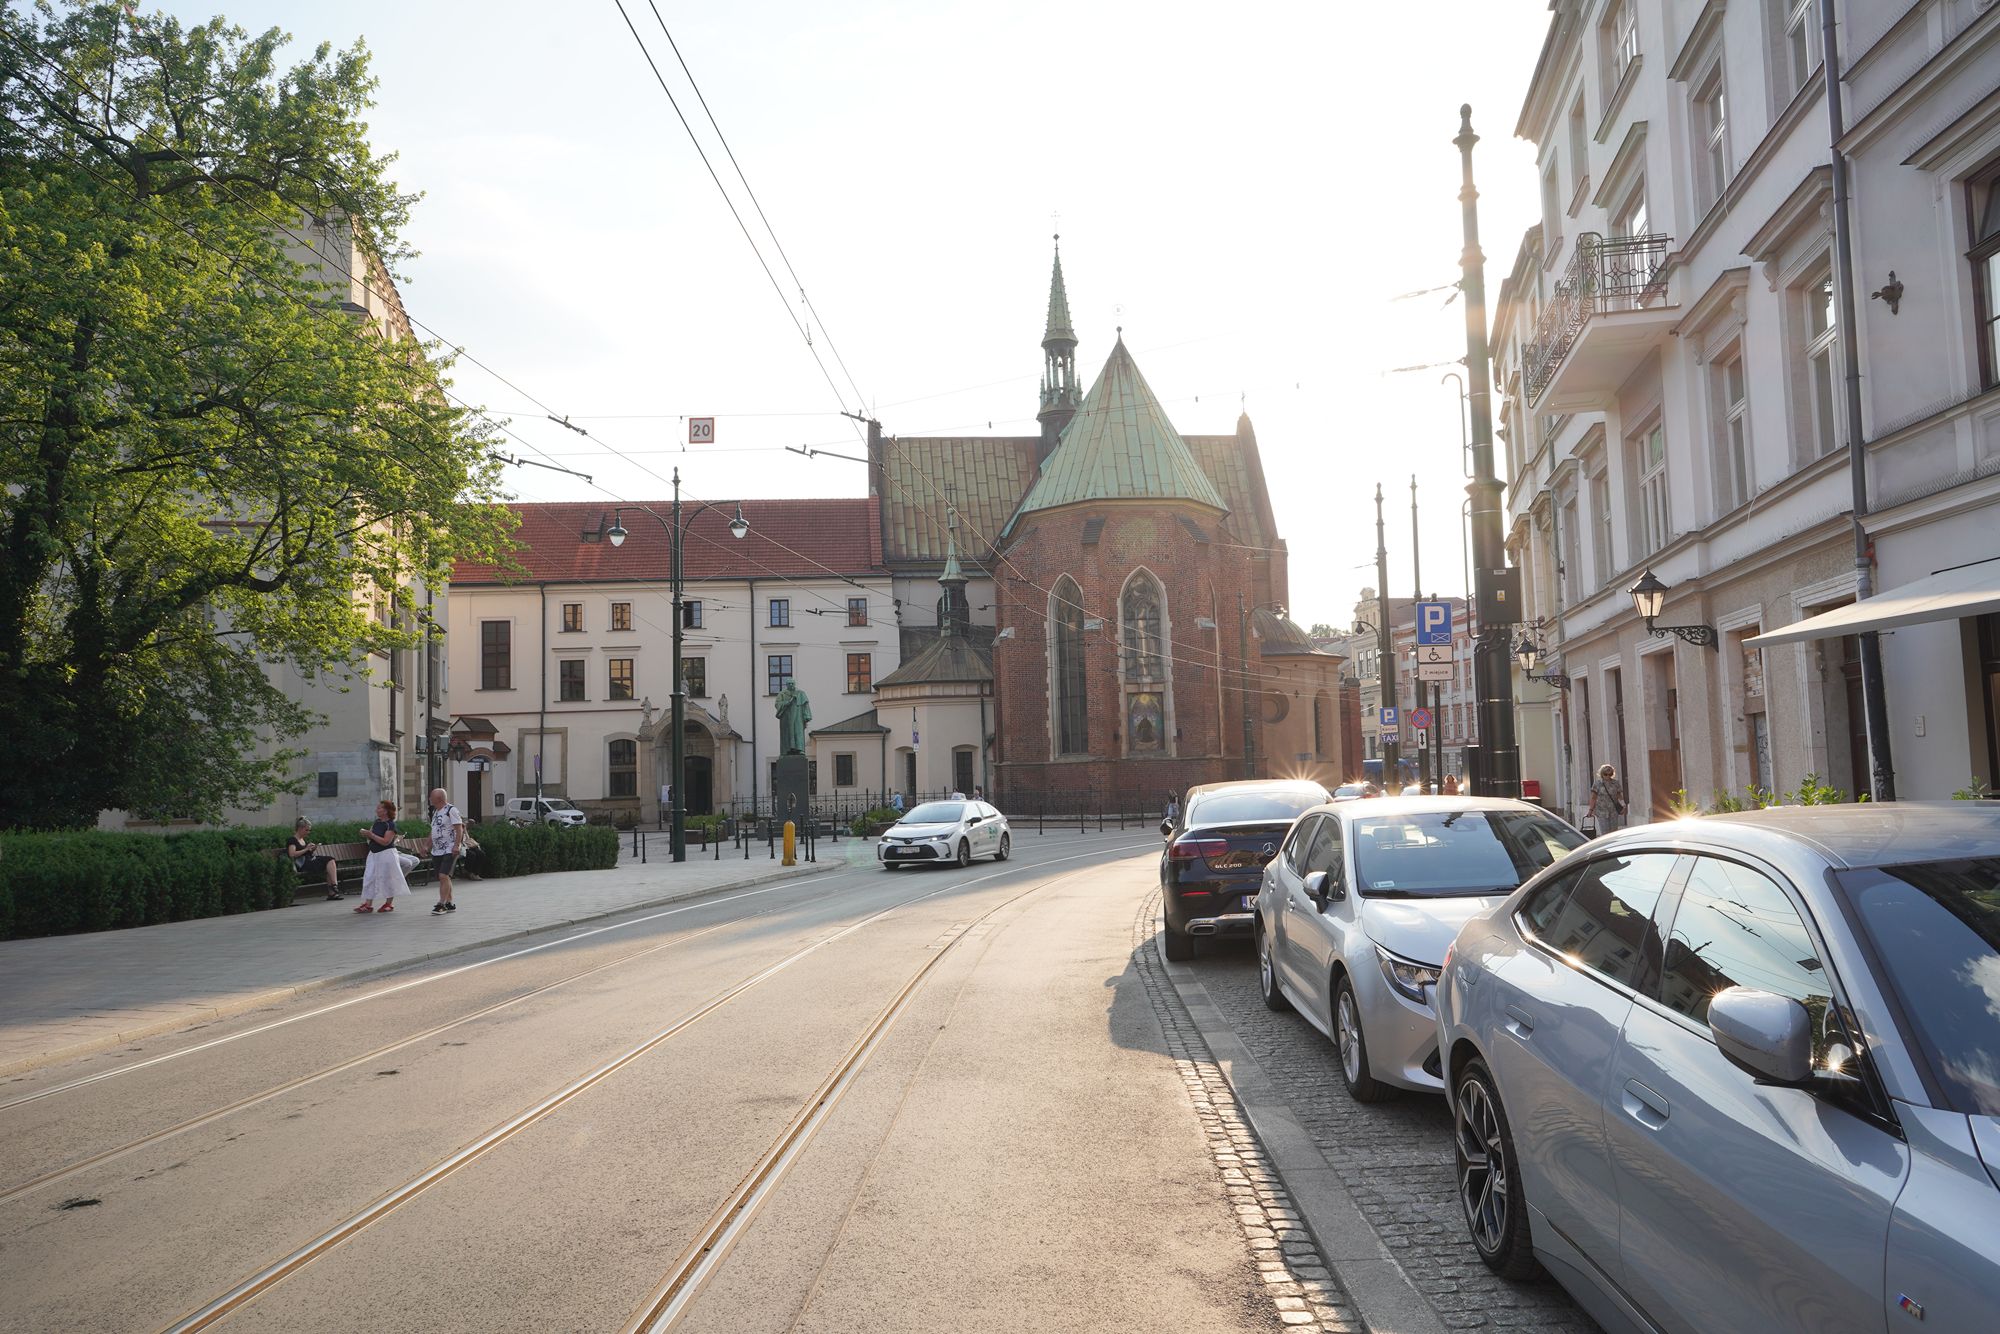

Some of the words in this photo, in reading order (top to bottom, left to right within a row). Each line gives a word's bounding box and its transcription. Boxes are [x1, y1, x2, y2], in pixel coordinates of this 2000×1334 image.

[693, 425, 710, 437] 20
[1424, 605, 1445, 633] P
[1384, 709, 1394, 723] P
